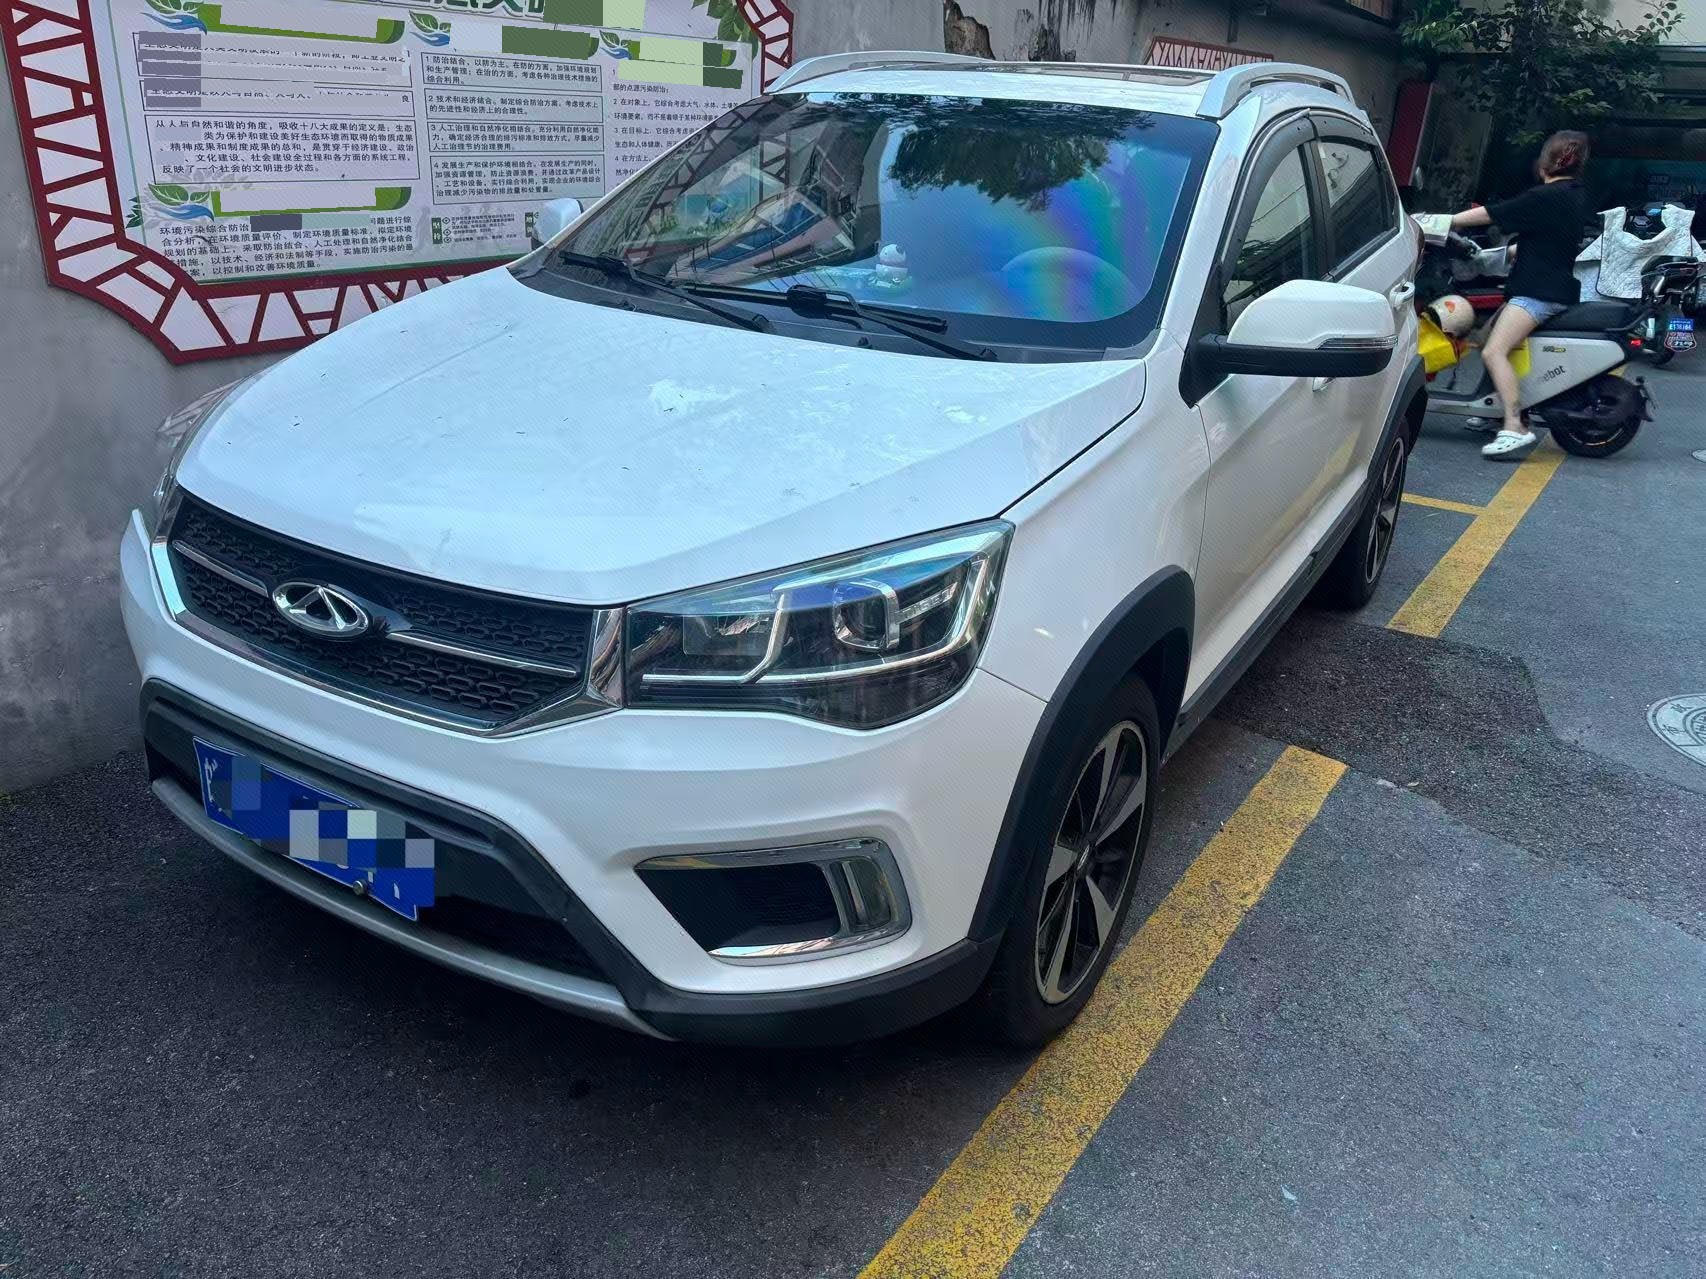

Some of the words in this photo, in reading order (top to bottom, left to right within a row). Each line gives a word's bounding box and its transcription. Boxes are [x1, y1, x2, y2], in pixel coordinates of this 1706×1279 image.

[171, 244, 413, 267] 措施，以技术、经济和法制等手段，实施防治污染的最
[187, 260, 321, 277] 案，以控制和改善环境质量。
